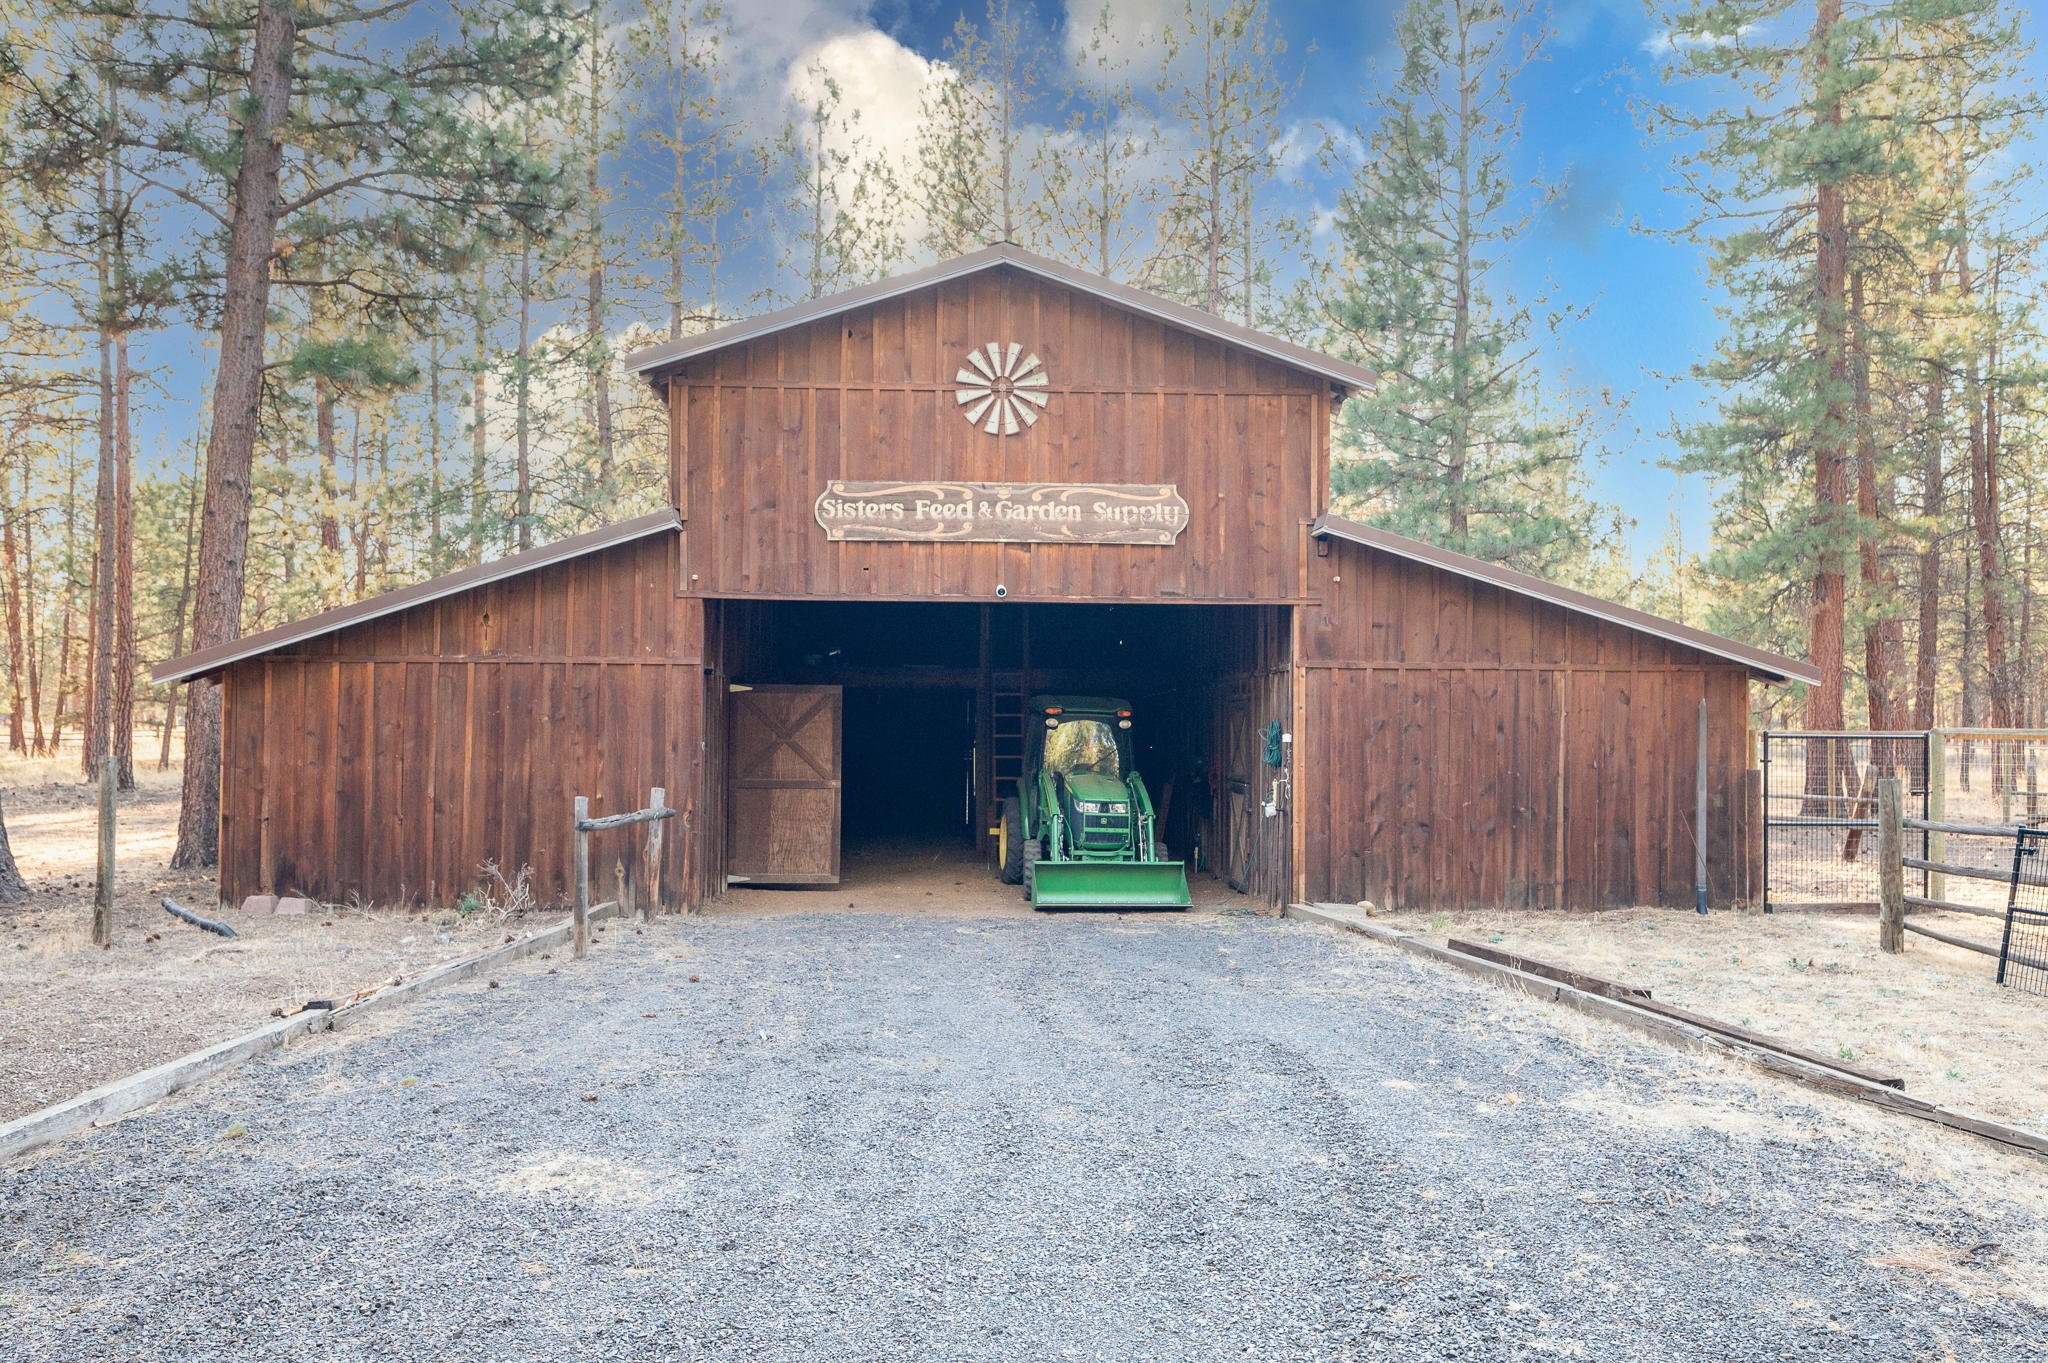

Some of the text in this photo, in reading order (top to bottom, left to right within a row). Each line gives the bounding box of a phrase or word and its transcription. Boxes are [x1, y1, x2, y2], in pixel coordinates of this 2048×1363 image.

[822, 499, 1180, 526] Sisters Feed & Garden Supply
